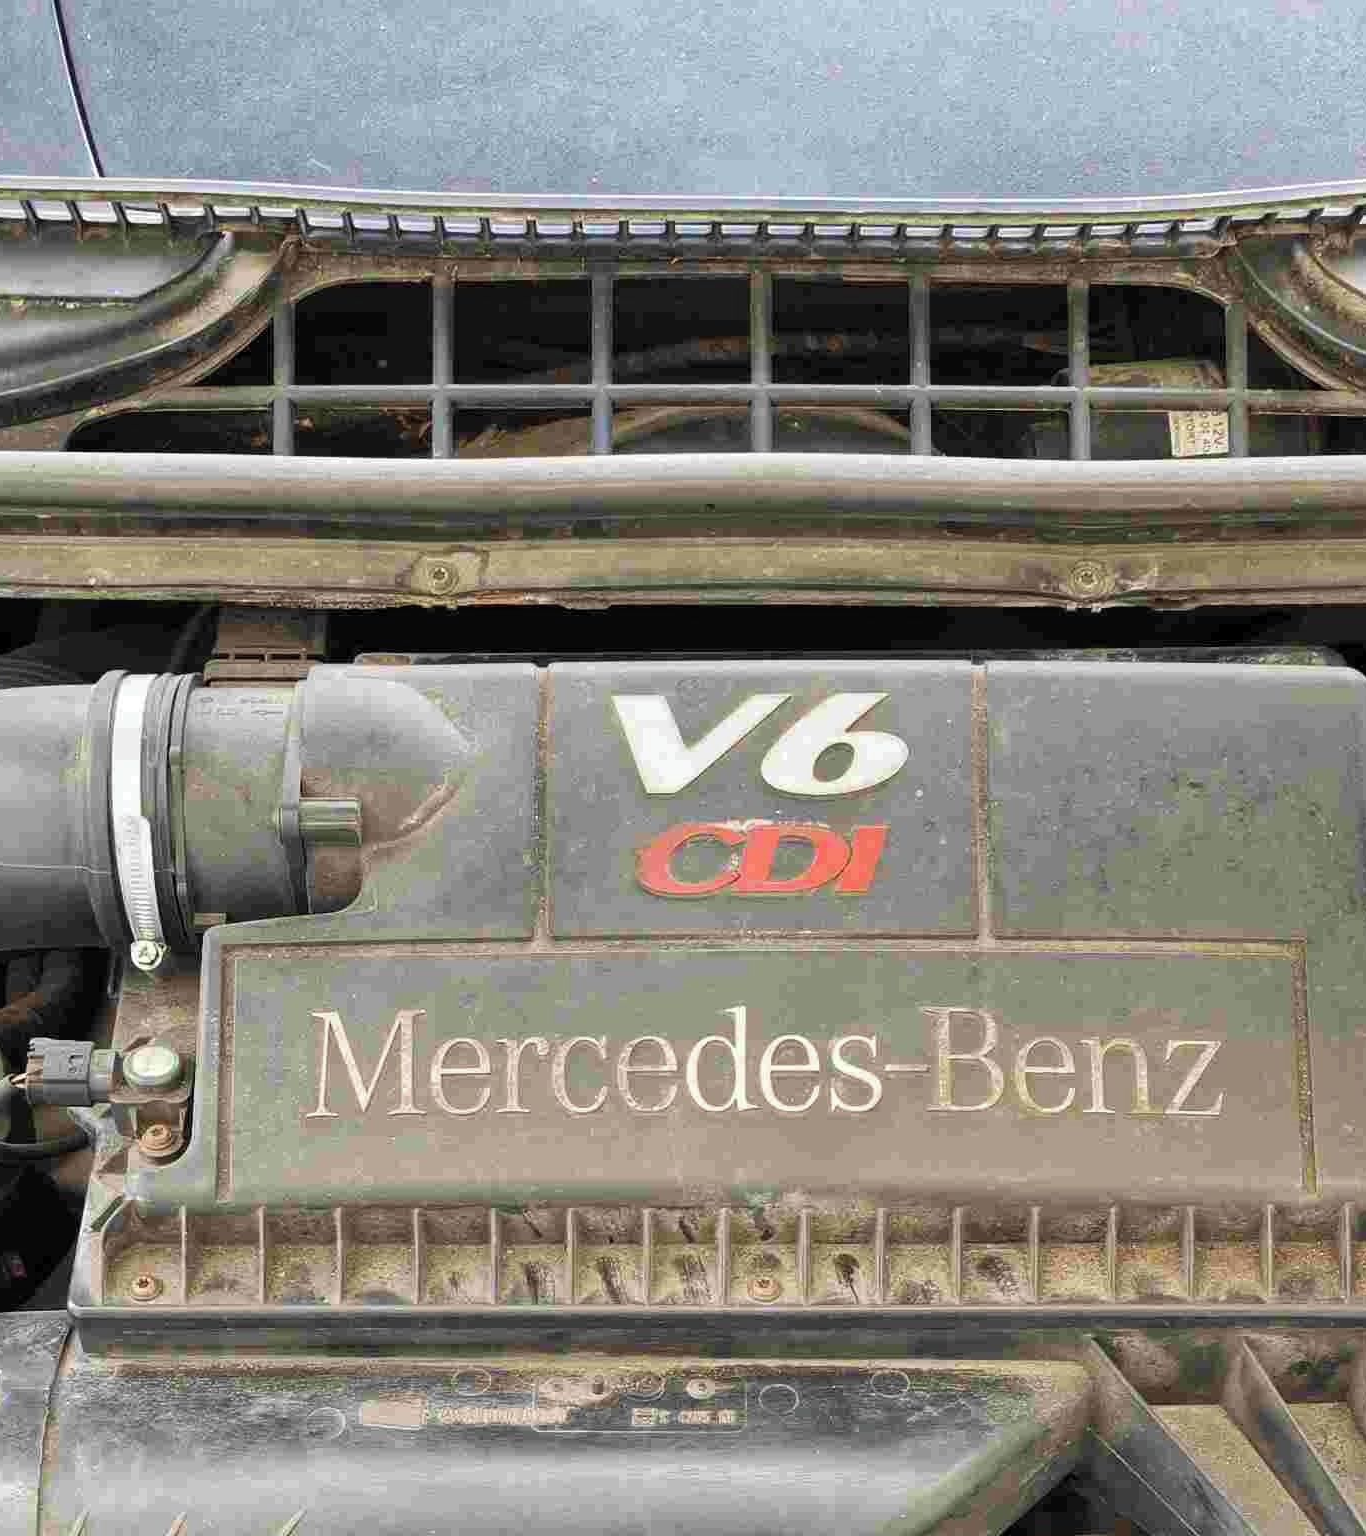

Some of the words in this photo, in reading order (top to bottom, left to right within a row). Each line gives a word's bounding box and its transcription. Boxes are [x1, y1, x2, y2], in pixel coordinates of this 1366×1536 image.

[610, 692, 910, 797] V6
[634, 820, 891, 897] CDI
[304, 1004, 1226, 1120] Mercedes-Benz
